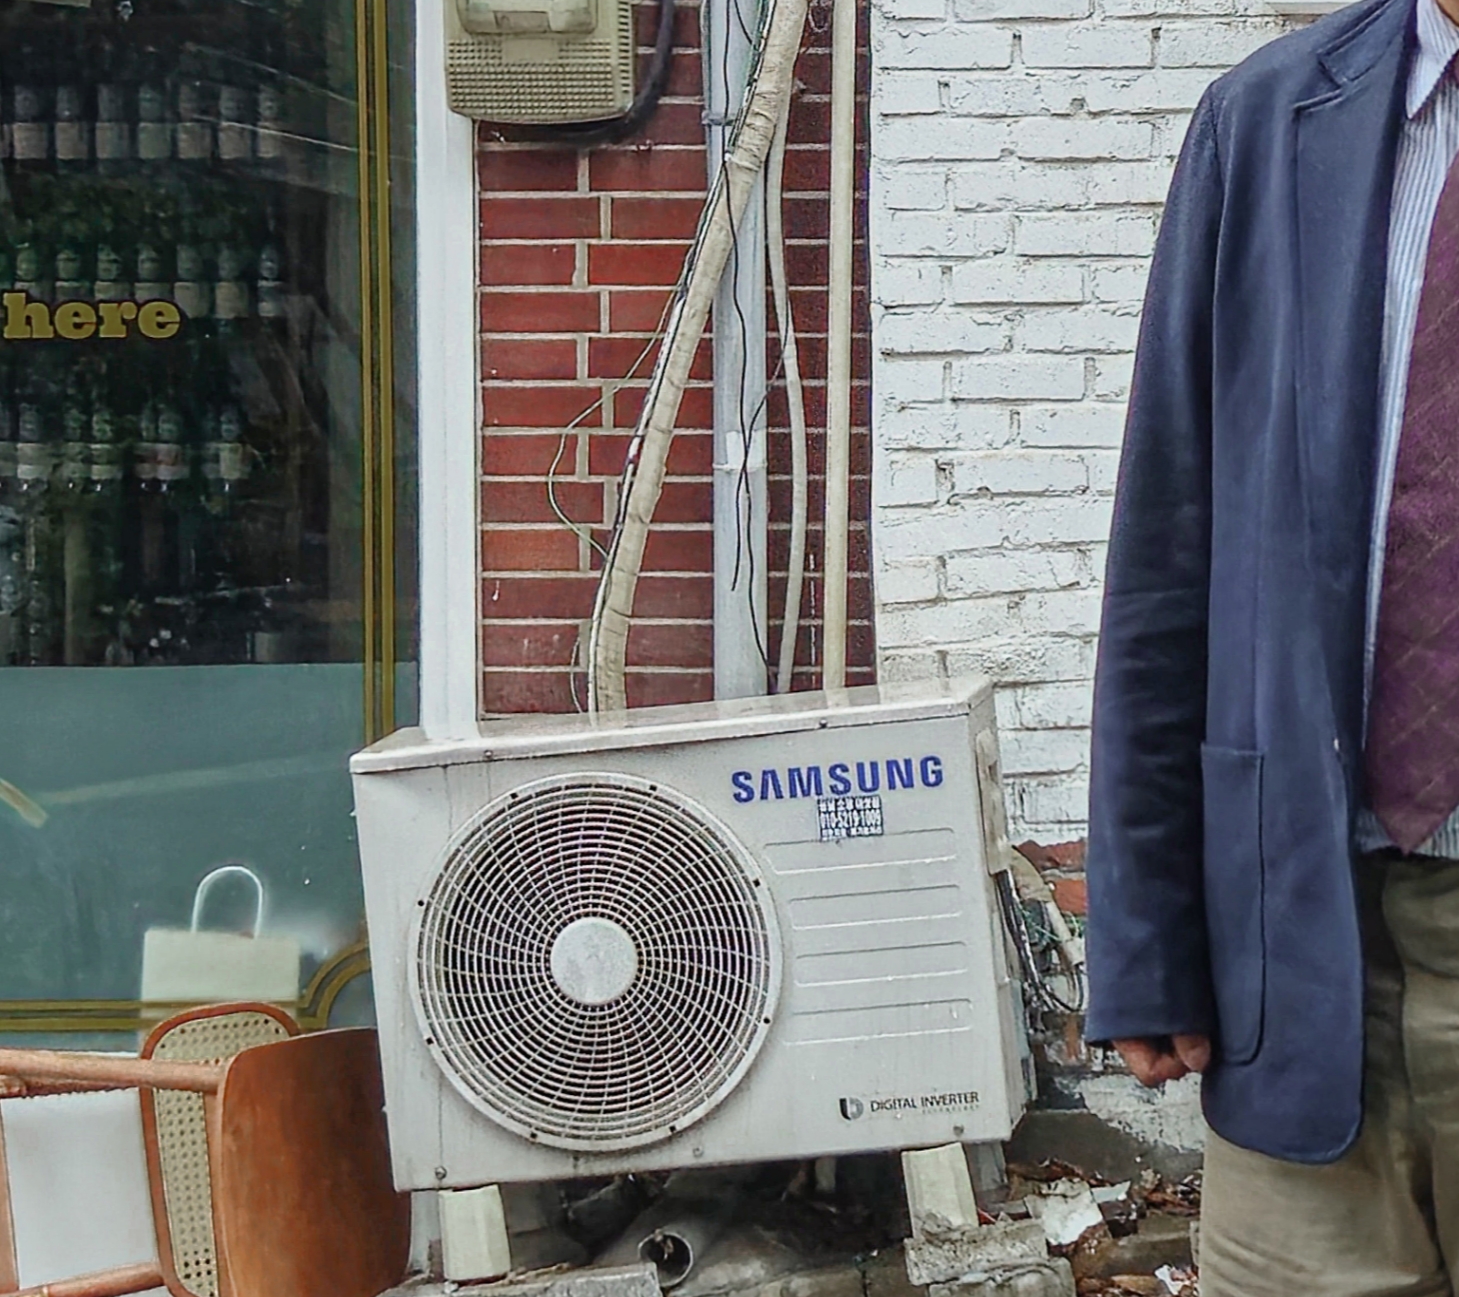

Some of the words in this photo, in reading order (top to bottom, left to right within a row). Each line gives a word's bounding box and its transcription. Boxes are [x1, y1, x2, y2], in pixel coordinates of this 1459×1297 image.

[3, 292, 181, 339] here
[731, 755, 944, 804] SAMSUNG
[870, 1098, 917, 1113] DIGITAL
[920, 1091, 979, 1108] INVERTER
